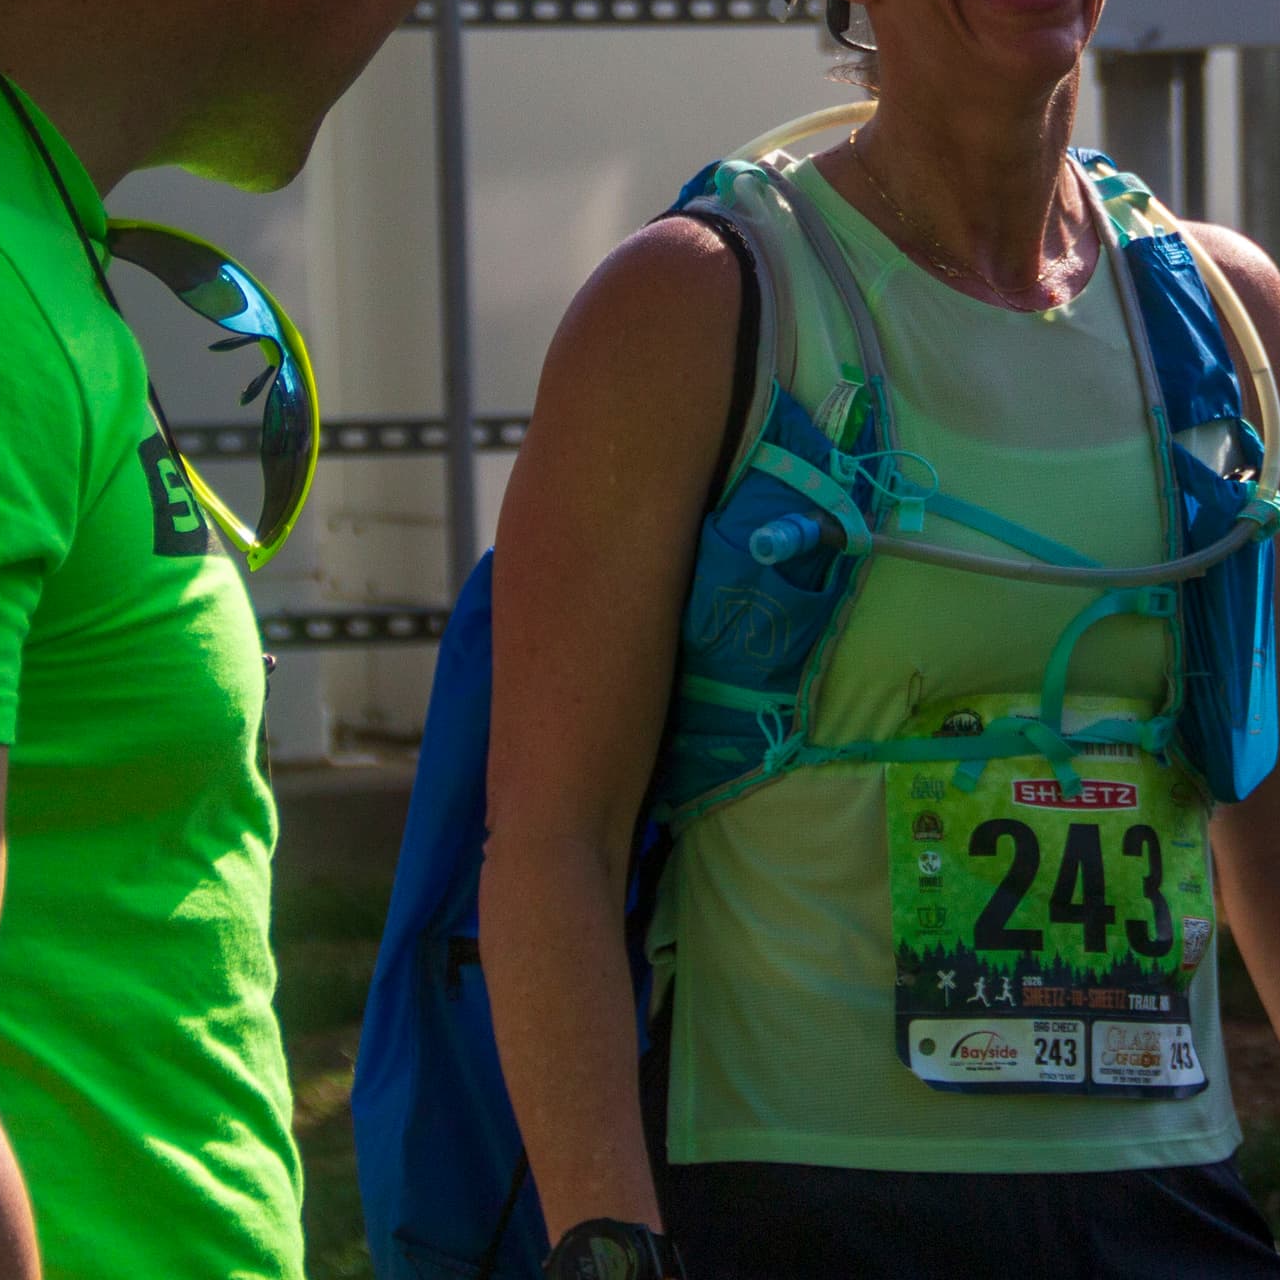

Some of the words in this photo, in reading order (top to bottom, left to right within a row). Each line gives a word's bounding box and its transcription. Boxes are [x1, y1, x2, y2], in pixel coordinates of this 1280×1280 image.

[968, 818, 1174, 958] 243
[1128, 993, 1158, 1011] TRAIL
[1033, 1021, 1050, 1033] BAG
[1051, 1022, 1079, 1033] CHECK
[960, 1045, 1018, 1060] Bayside
[1033, 1037, 1078, 1067] 243
[1170, 1042, 1194, 1070] 243
